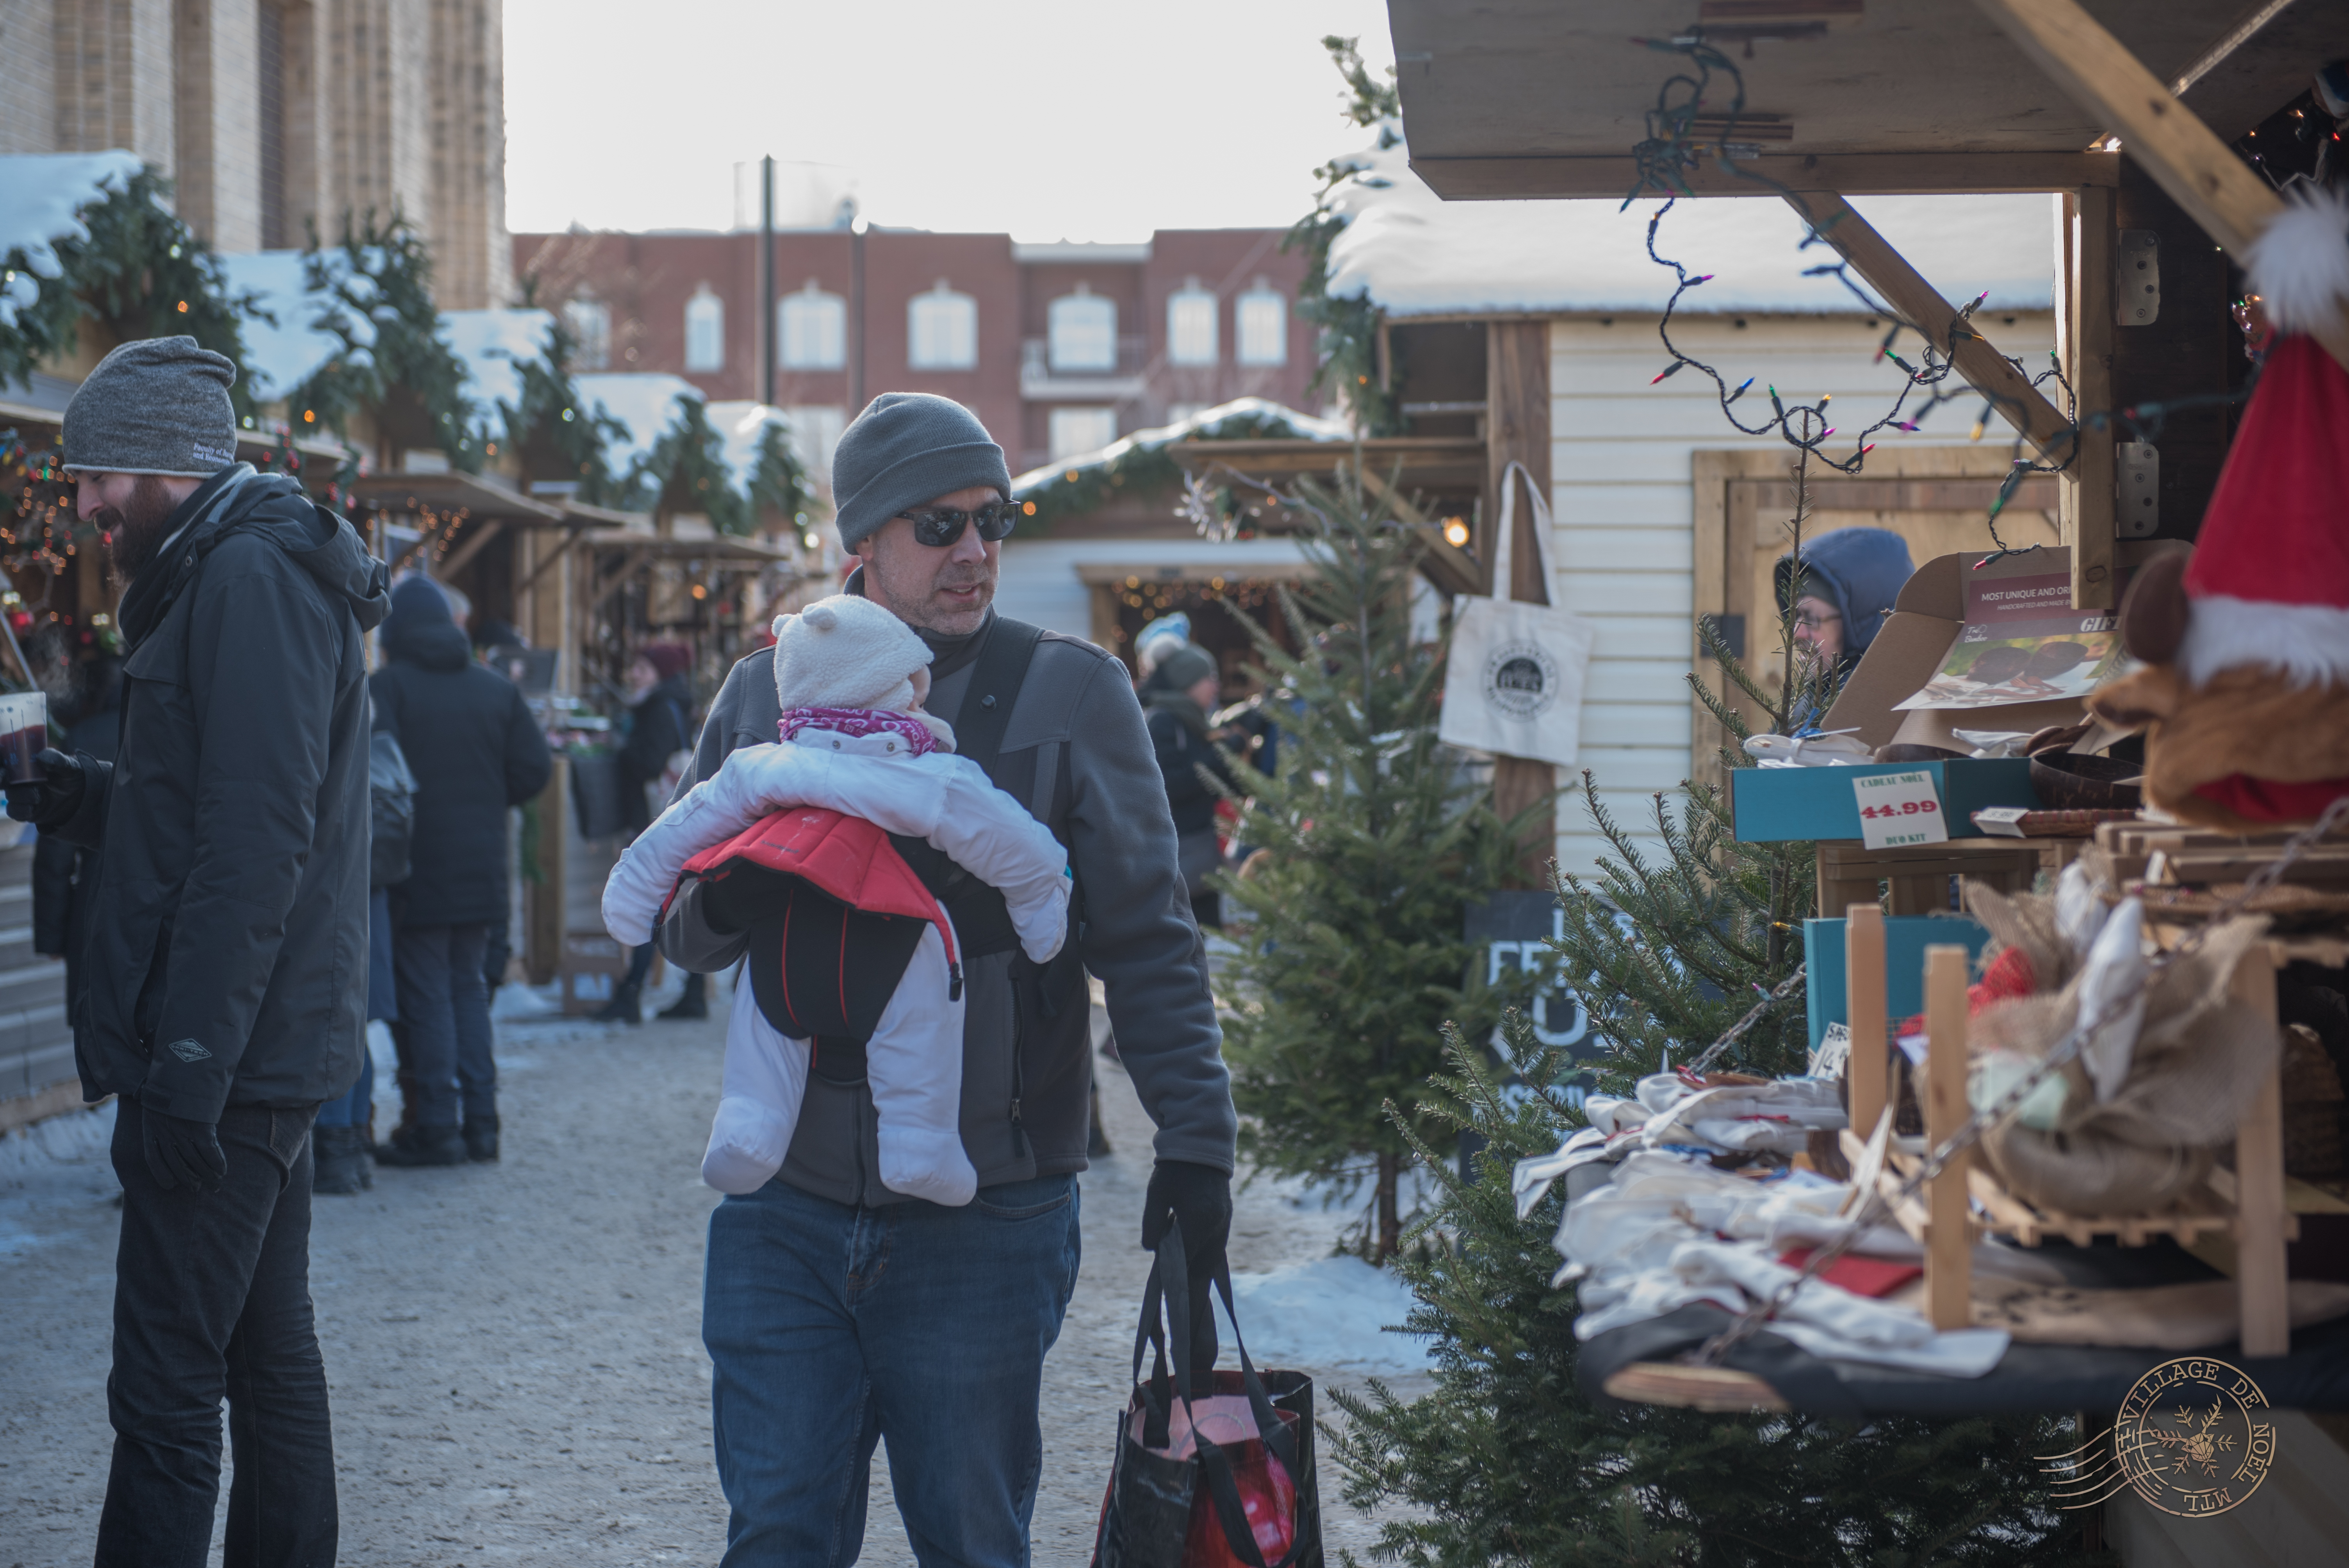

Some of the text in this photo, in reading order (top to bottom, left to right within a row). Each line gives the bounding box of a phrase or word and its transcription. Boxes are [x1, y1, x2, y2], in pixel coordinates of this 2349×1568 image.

[194, 442, 215, 455] Faculty
[193, 451, 204, 460] and
[1981, 592, 2005, 601] MOST
[2005, 589, 2037, 599] UNIQUE
[2037, 587, 2056, 596] AND
[1997, 602, 2036, 610] HANDCRAFTED
[1861, 777, 1898, 788] CADEAU
[1861, 800, 1937, 819] 44.99
[1885, 833, 1927, 845] DUO KIT
[171, 1044, 208, 1056] OMNI-TECH
